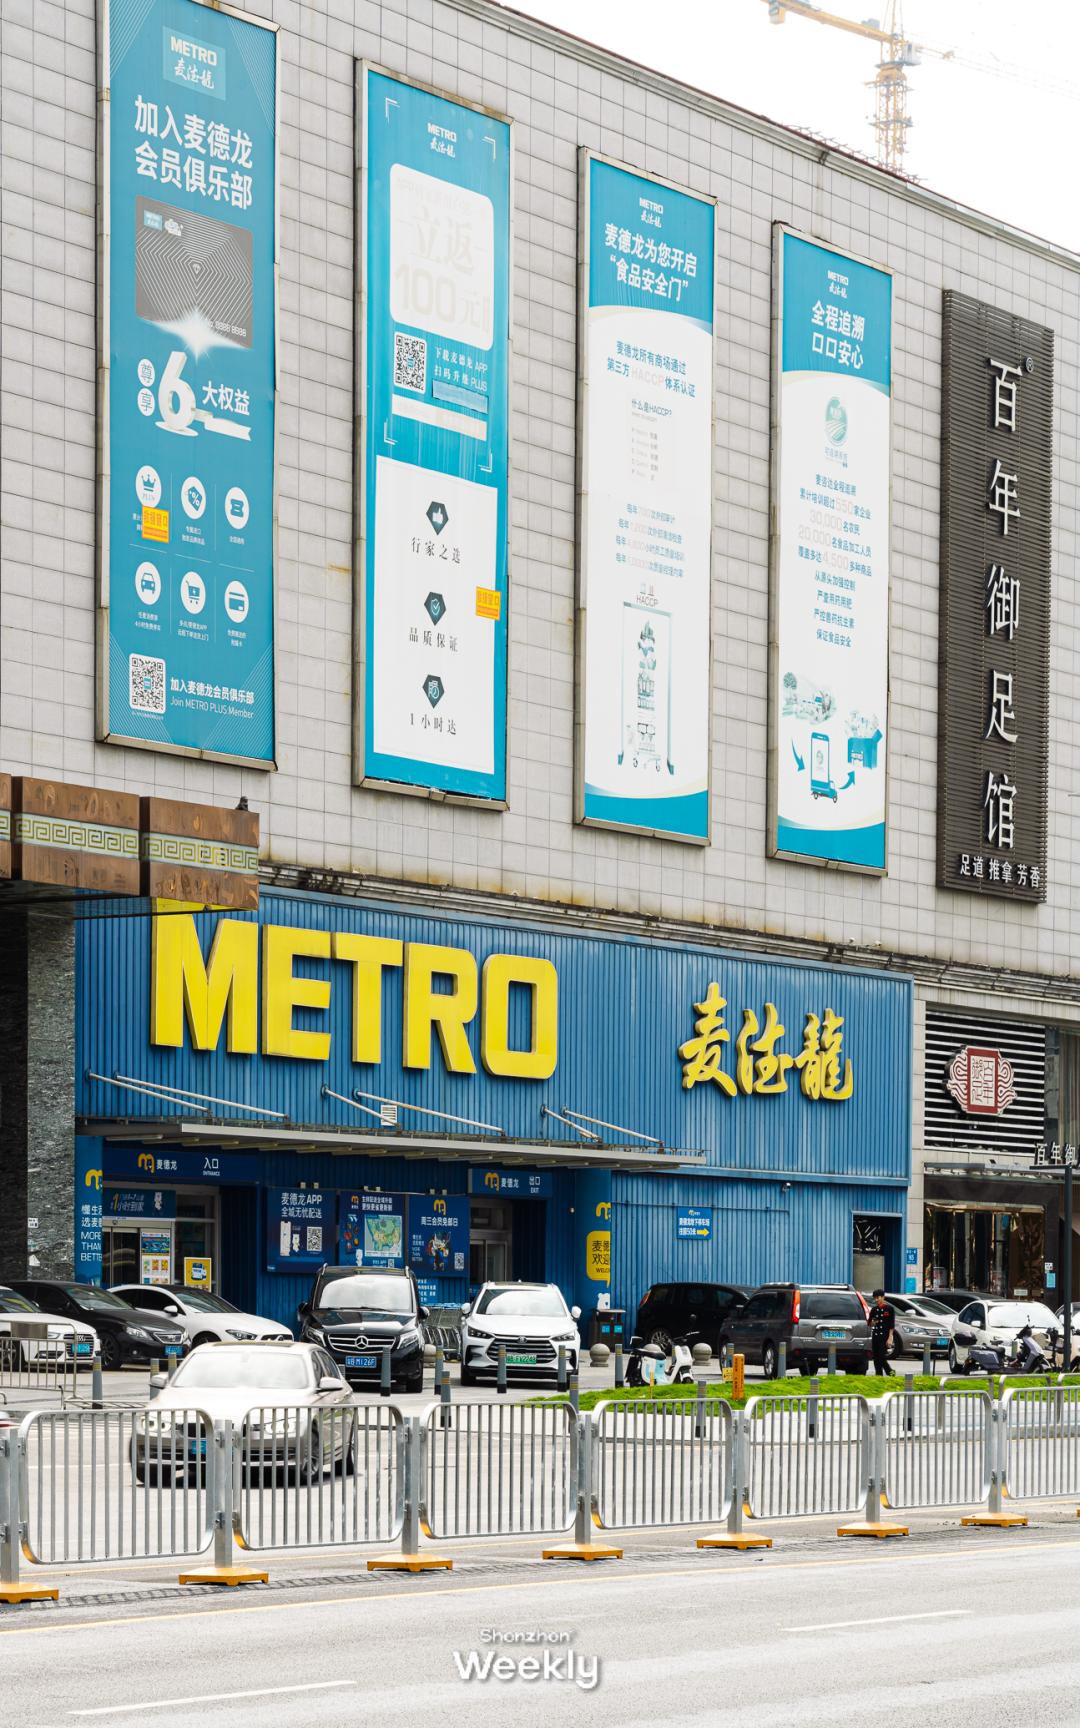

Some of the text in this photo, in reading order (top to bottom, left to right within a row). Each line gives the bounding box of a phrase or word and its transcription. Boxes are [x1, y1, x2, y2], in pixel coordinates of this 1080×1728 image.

[170, 36, 217, 66] METRO
[134, 95, 253, 169] 加入麦德龙
[427, 123, 457, 143] METRO
[134, 140, 252, 210] 会员俱乐部
[640, 197, 664, 214] METRO
[605, 223, 697, 278] 麦德龙为您开启
[828, 270, 848, 285] METRO
[811, 300, 865, 341] 全程追溯
[616, 340, 687, 375] 麦德龙所有商场通过
[812, 332, 864, 369] 口口安心
[158, 351, 196, 429] 6
[202, 380, 250, 416] 大权益
[470, 378, 488, 392] PLUS
[607, 357, 630, 377] 第三方
[664, 376, 696, 398] 体系认证
[410, 536, 461, 564] 行家之选
[984, 357, 1022, 849] 百年御足馆
[408, 627, 458, 652] 品质保证
[170, 676, 255, 705] 加入麦德龙会员俱乐部
[170, 695, 254, 719] Join METRO PLUS Member
[960, 853, 1041, 889] 足道 推拿 芳香
[150, 897, 558, 1080] METRO
[156, 1157, 219, 1171] 麦德龙 入口
[501, 1176, 541, 1189] 麦德龙 出口
